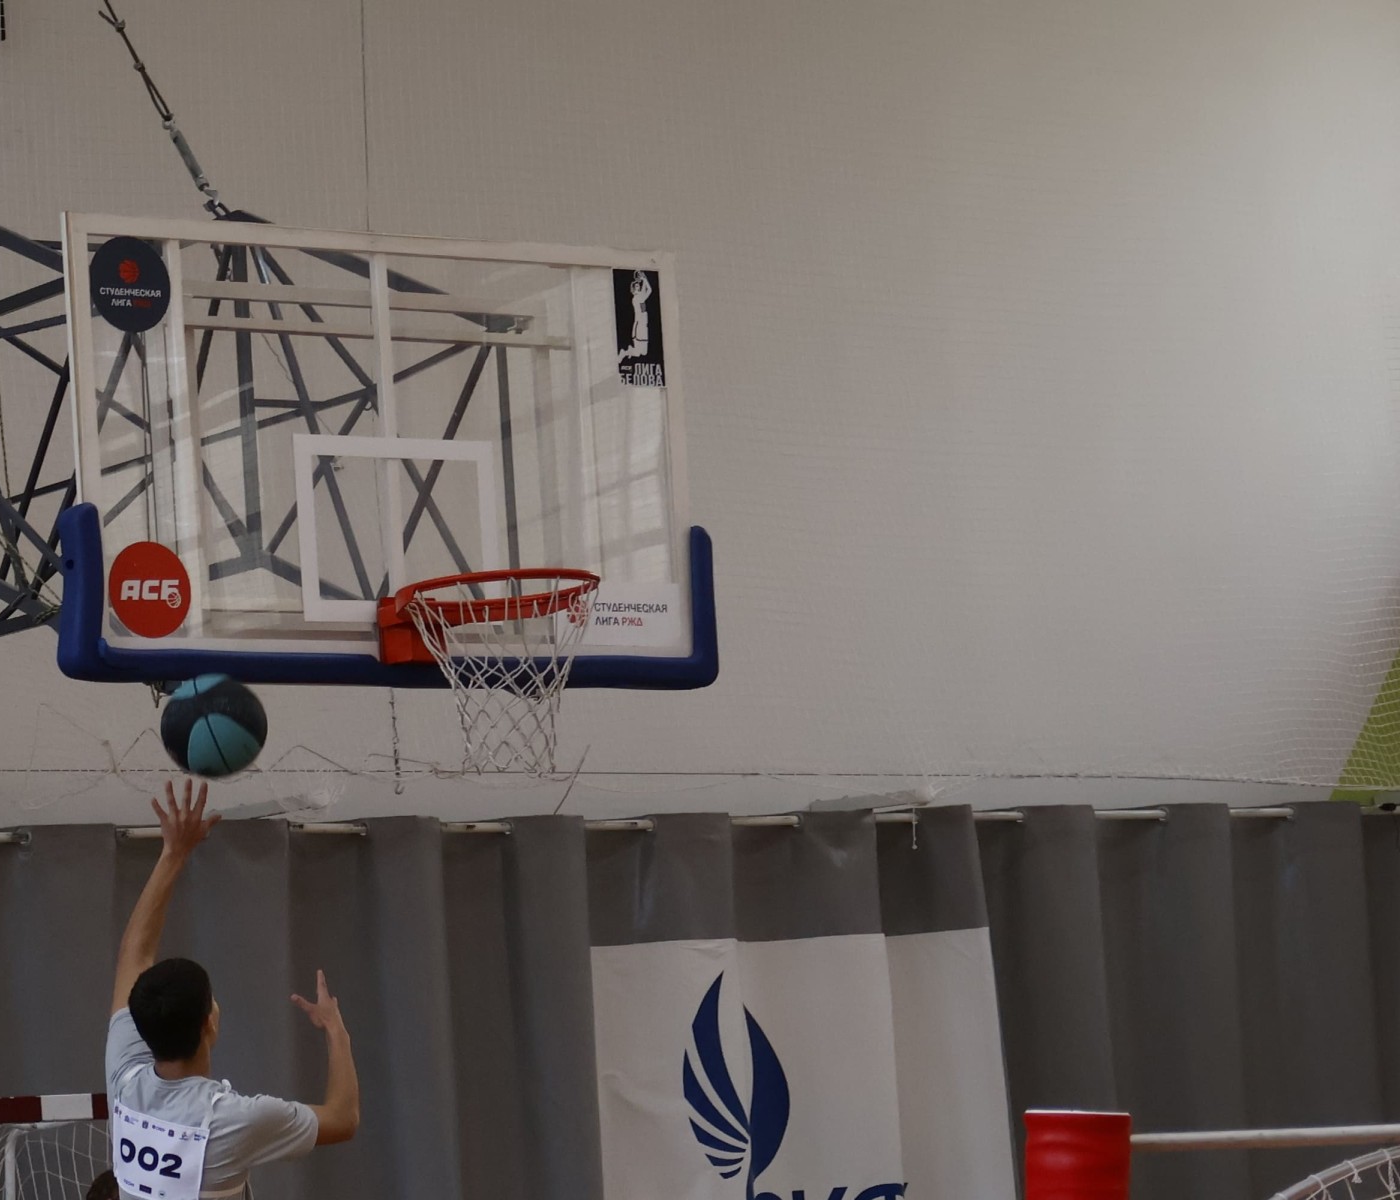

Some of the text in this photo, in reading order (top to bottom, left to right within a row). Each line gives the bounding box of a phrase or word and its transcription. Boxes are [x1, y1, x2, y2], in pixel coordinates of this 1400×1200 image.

[99, 286, 162, 298] СТУДЕНЧЕСКАЯ
[634, 362, 663, 376] ЛИГА
[120, 579, 181, 608] АСБ
[594, 602, 668, 613] СТУДЕНЧЕСКАЯ
[595, 616, 643, 627] ЛИГА РЖД
[120, 1137, 182, 1179] 002
